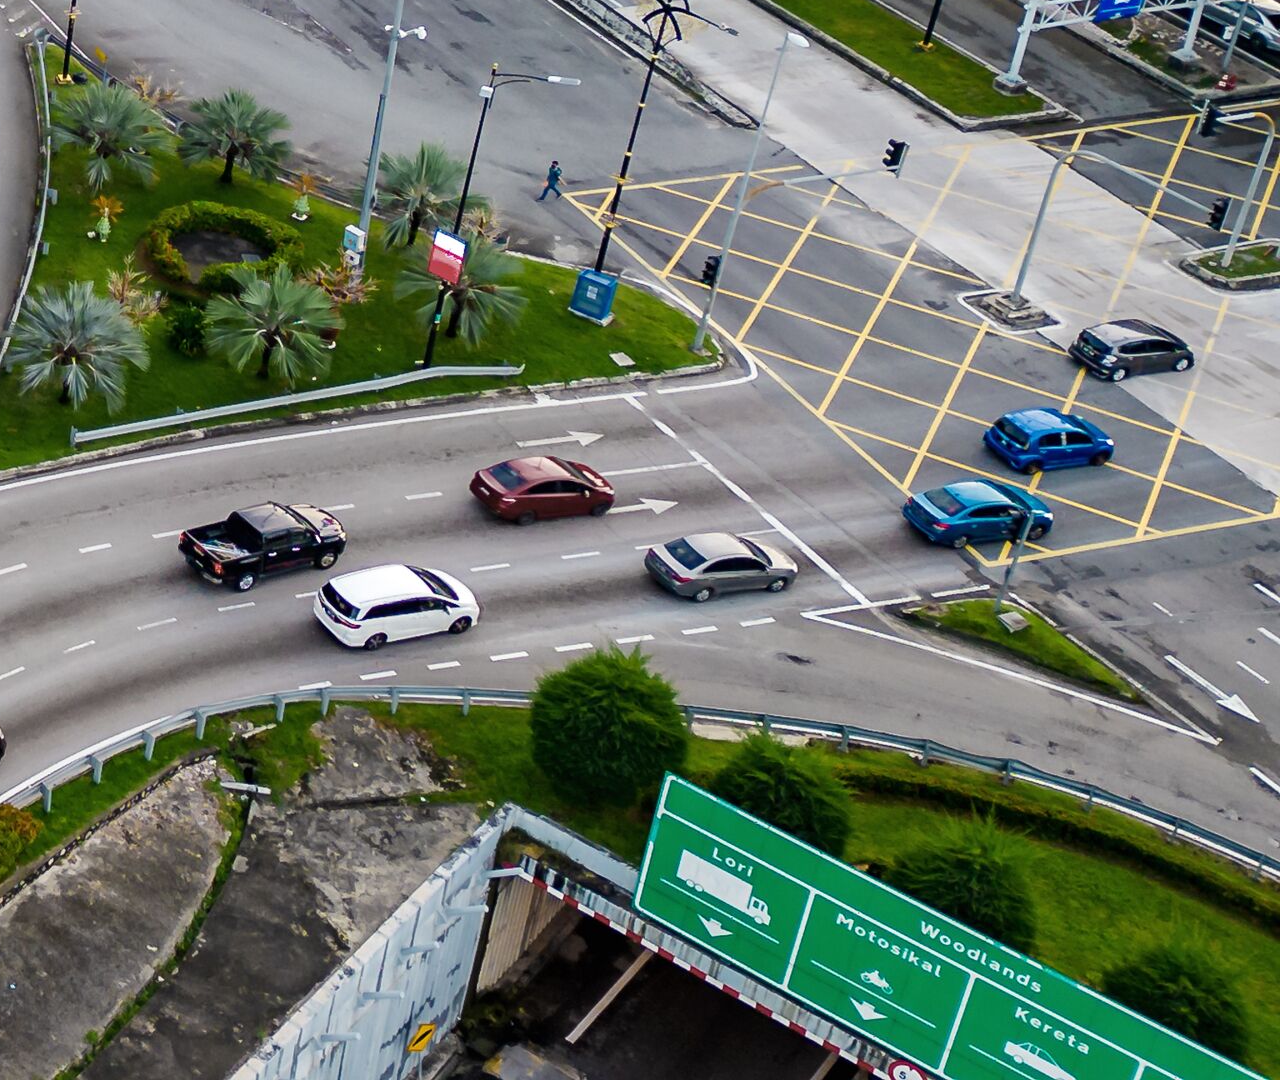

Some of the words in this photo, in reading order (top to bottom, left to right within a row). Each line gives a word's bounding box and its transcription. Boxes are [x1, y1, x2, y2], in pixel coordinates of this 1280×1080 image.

[709, 845, 755, 878] Lori
[834, 911, 943, 979] Motosikal
[918, 919, 1043, 994] Woodlands
[1013, 1006, 1091, 1056] Kereta
